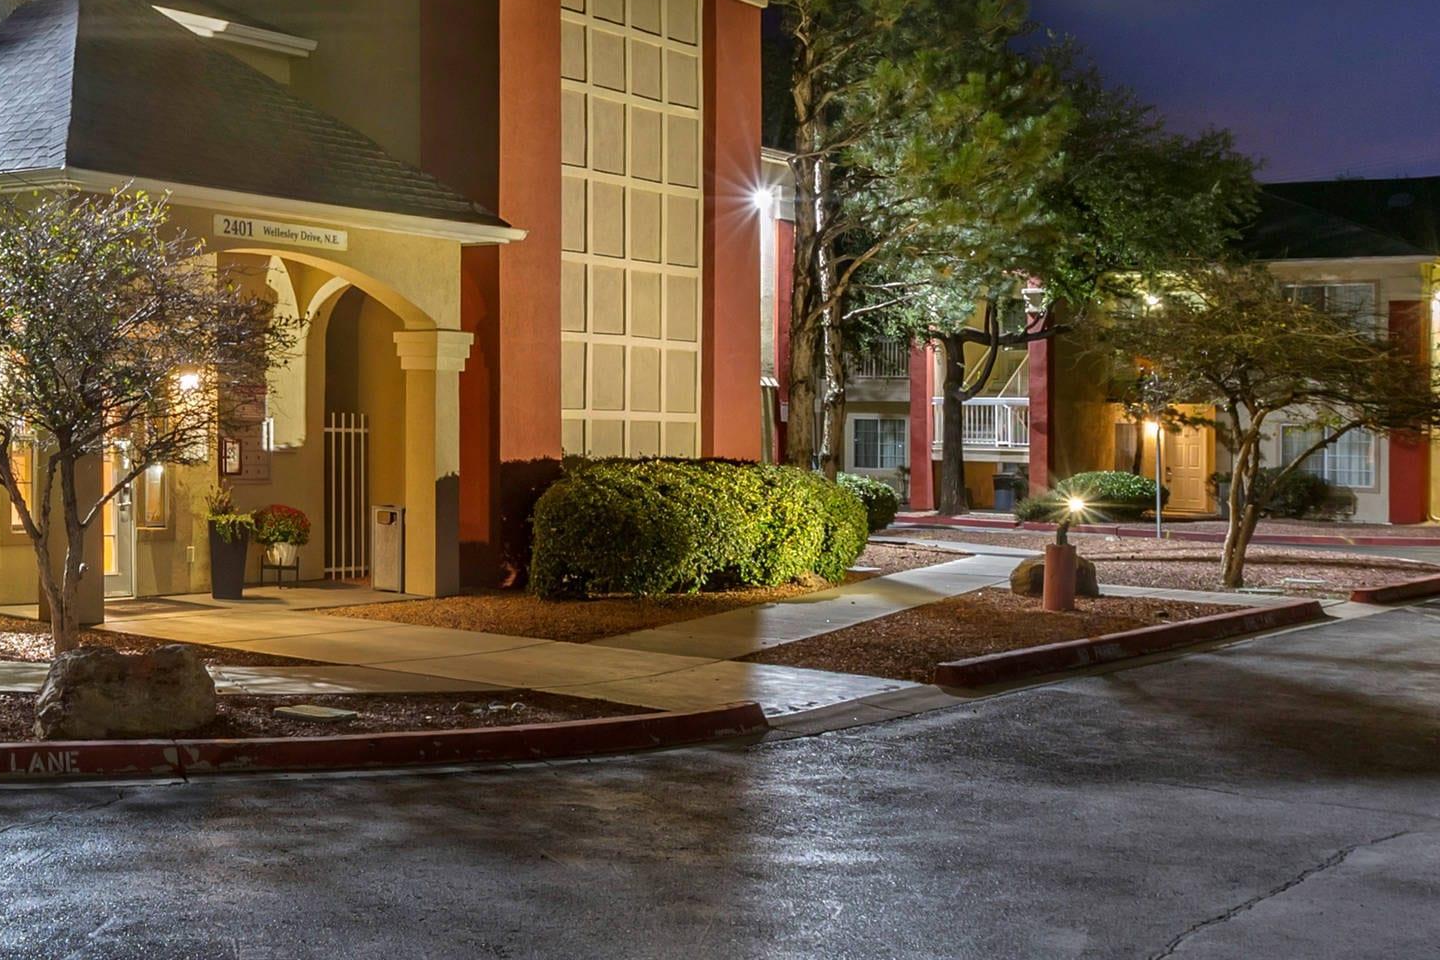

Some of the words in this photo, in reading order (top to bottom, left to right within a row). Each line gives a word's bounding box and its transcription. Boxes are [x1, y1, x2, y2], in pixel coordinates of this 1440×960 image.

[223, 218, 254, 237] 2401
[263, 226, 299, 243] Wellesley
[300, 230, 323, 244] Drive,
[10, 750, 80, 774] LANE
